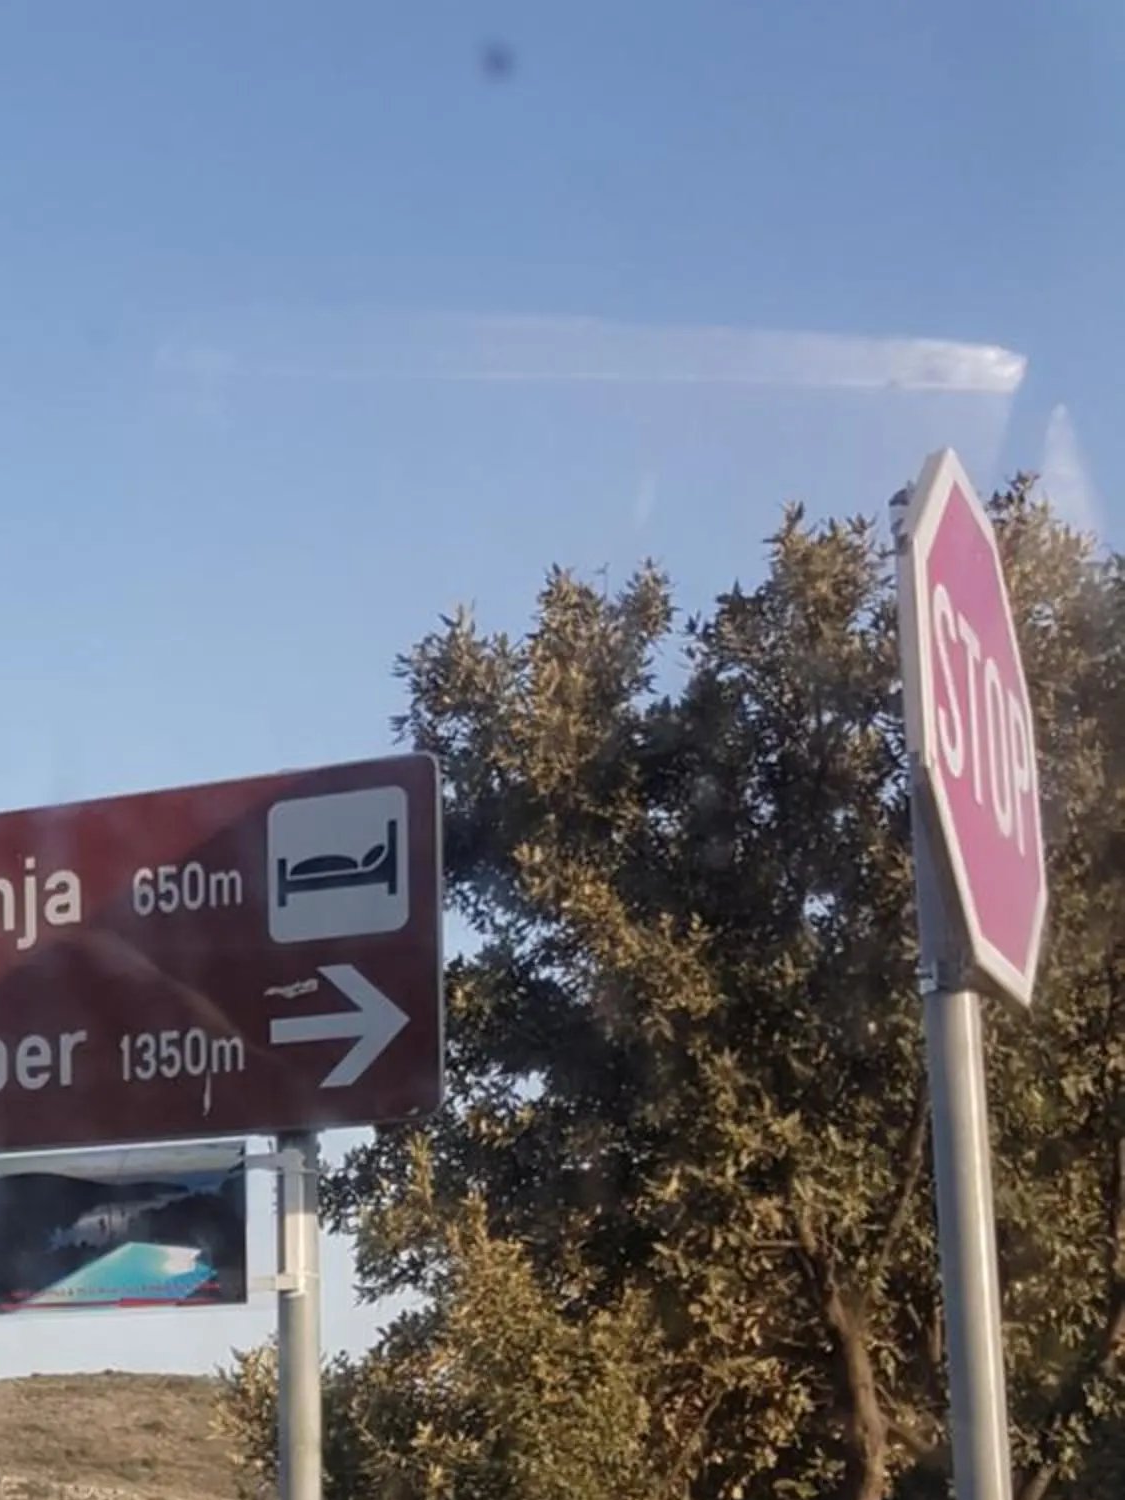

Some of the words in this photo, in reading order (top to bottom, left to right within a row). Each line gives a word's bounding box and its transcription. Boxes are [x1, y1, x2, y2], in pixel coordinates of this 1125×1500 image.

[933, 583, 1032, 857] STOP
[132, 861, 242, 915] 650m
[119, 1028, 245, 1081] 1350m
